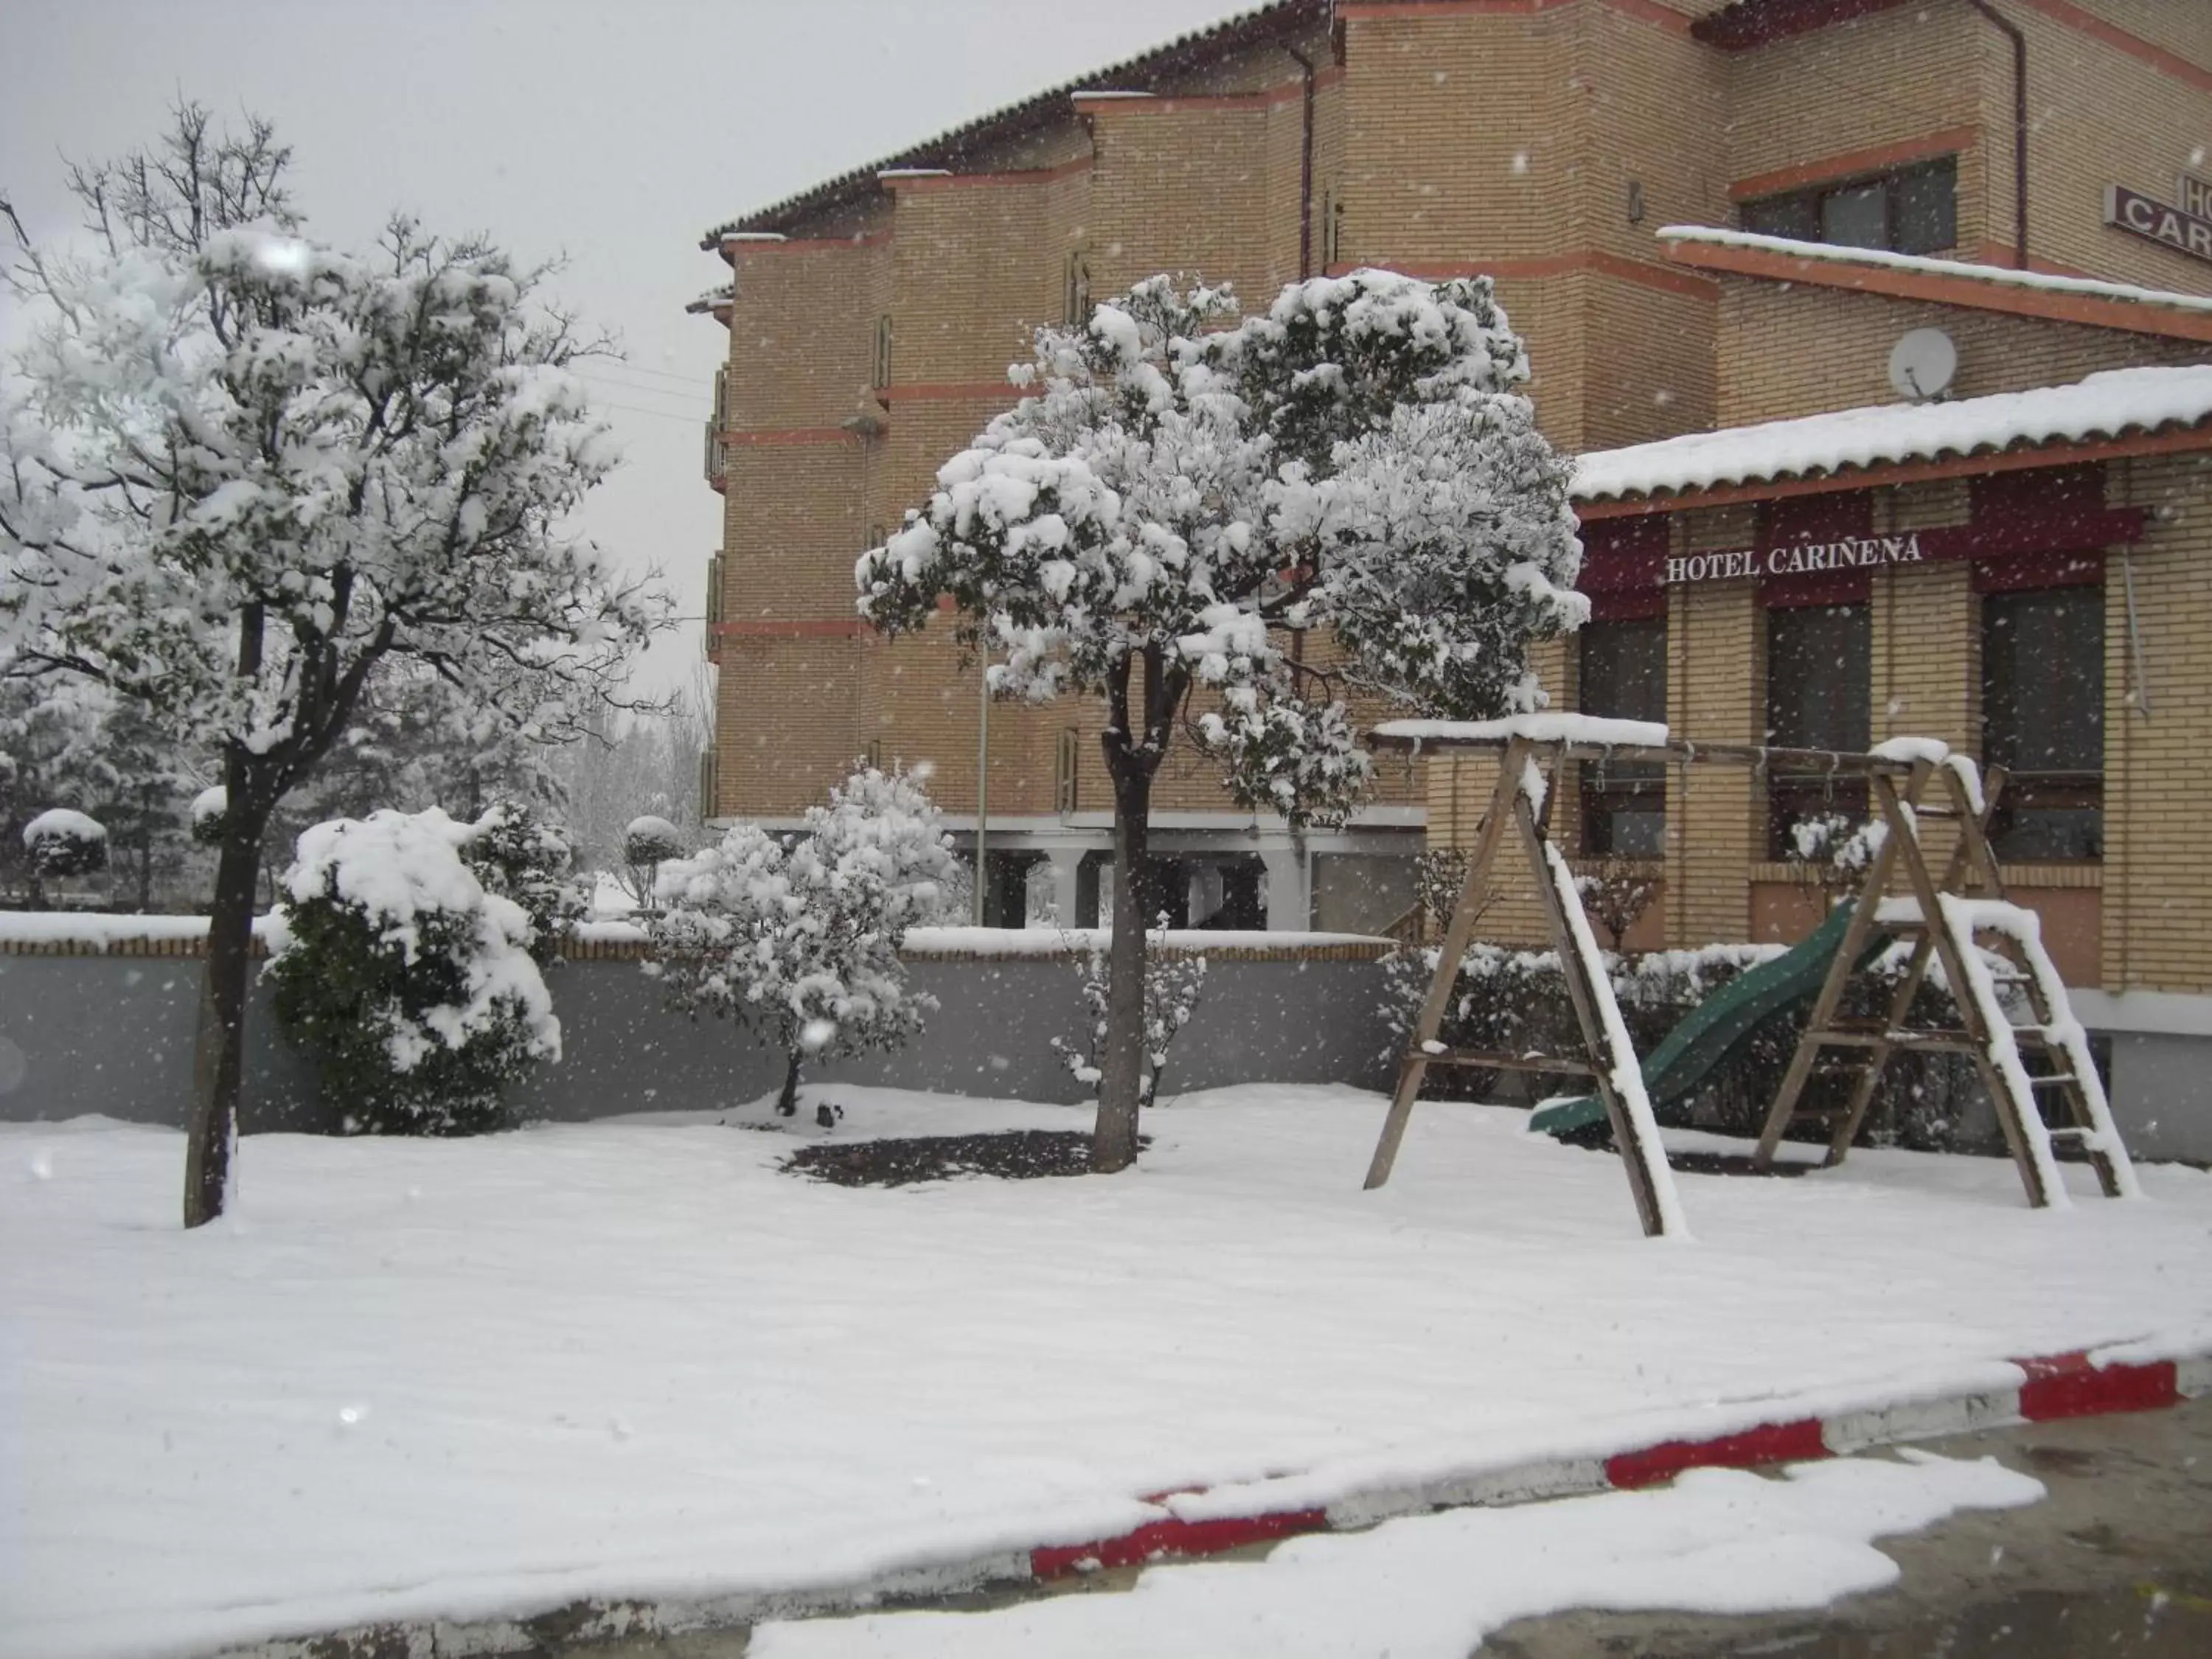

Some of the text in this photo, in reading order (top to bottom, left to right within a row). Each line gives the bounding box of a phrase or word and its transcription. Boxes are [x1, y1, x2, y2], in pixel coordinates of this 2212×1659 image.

[2125, 198, 2212, 256] CAR
[1667, 533, 1923, 582] HOTEL CARIÑENA
